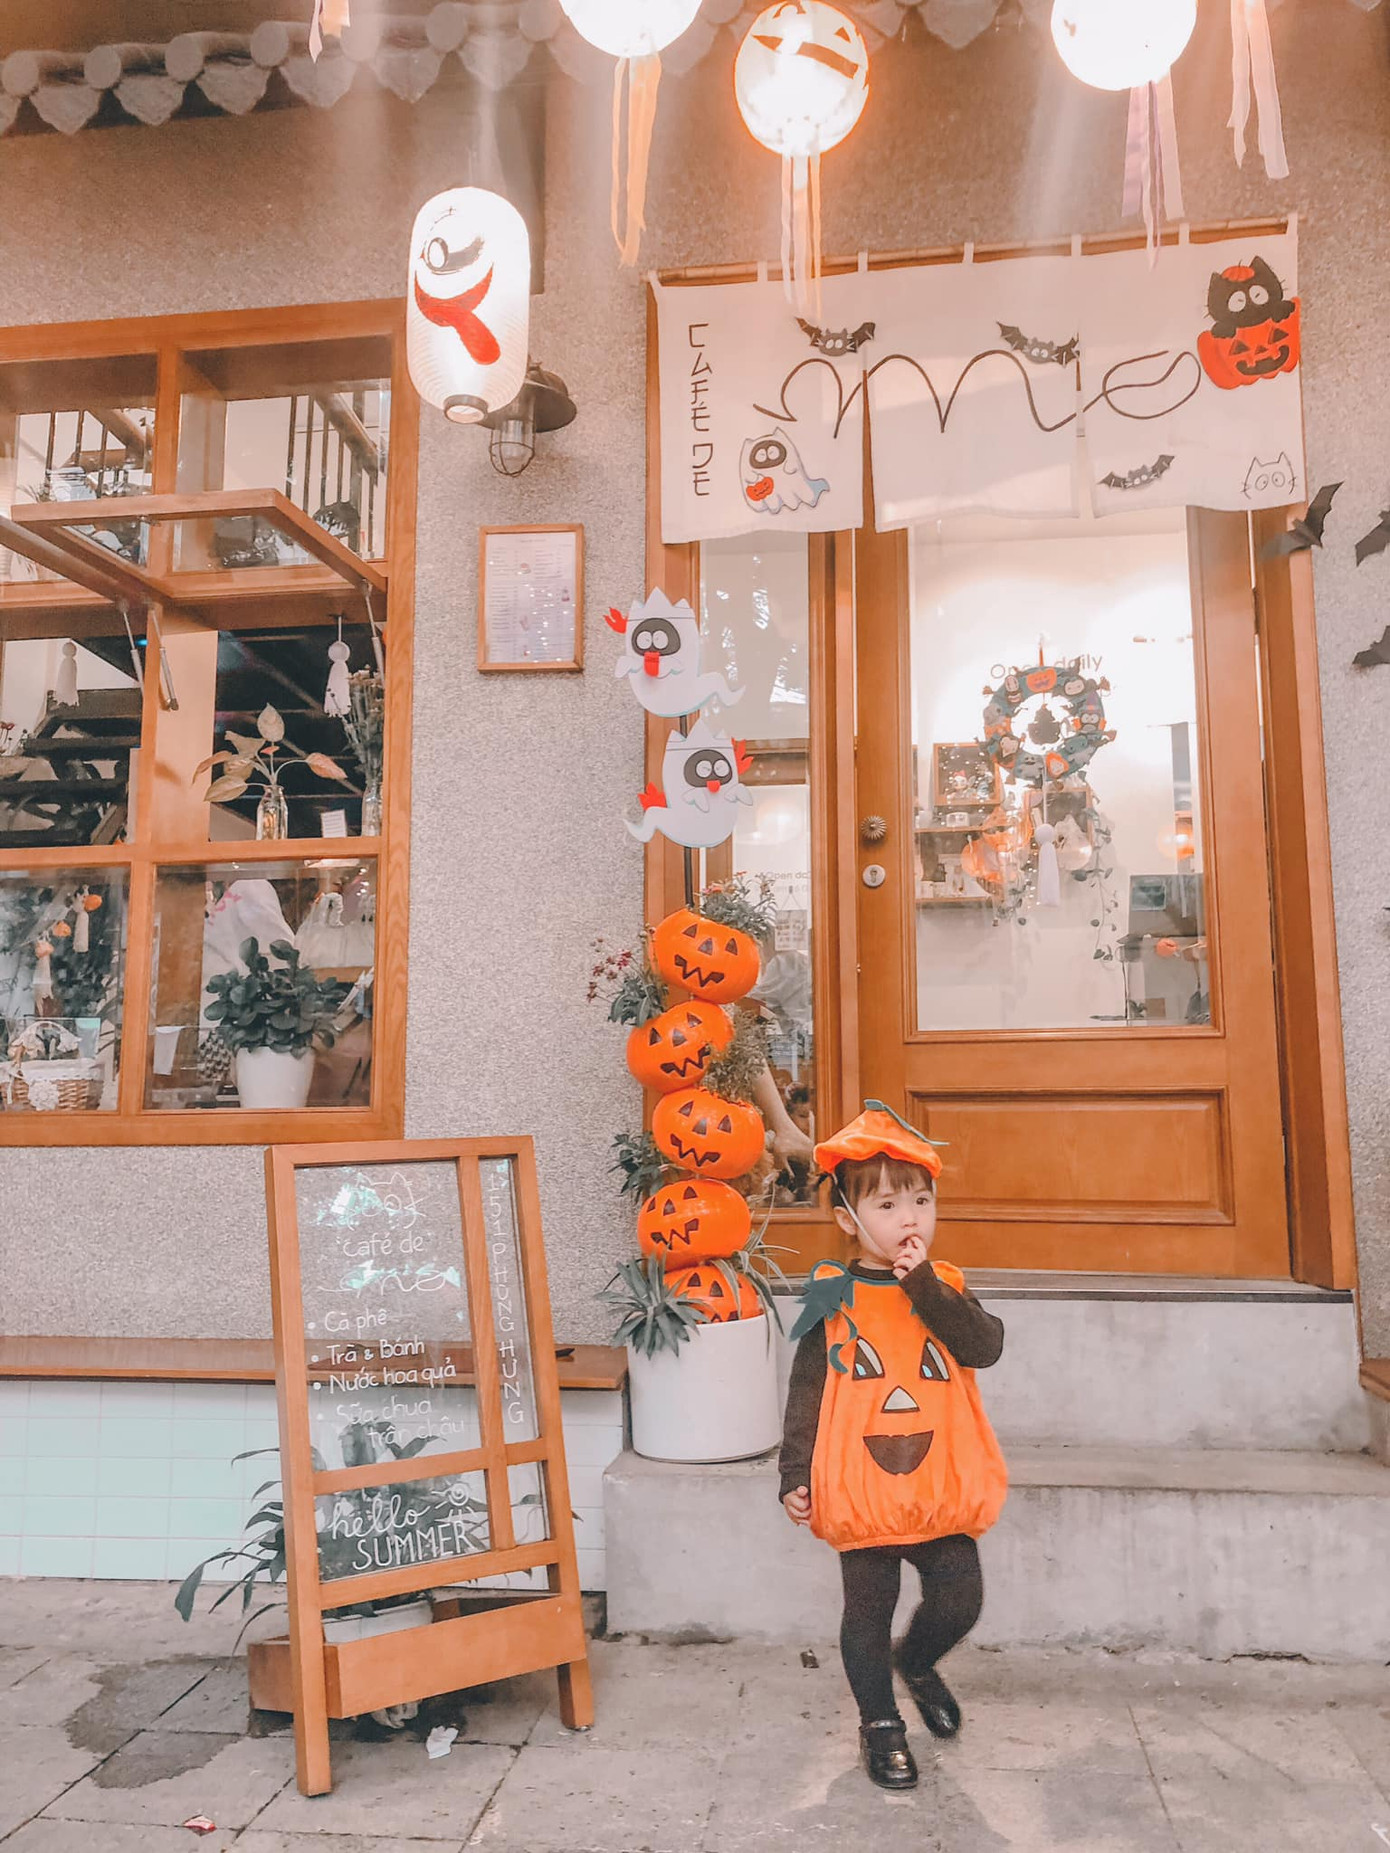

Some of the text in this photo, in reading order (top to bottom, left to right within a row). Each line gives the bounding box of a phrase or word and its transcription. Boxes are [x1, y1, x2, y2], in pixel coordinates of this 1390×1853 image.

[688, 323, 714, 496] CAFÉ DE
[356, 1308, 388, 1339] phê
[364, 1349, 374, 1361] &
[383, 1366, 418, 1385] hoa
[421, 1357, 456, 1388] quả
[382, 1395, 432, 1420] chua
[328, 1494, 431, 1540] hello
[352, 1520, 476, 1570] SUMMER
